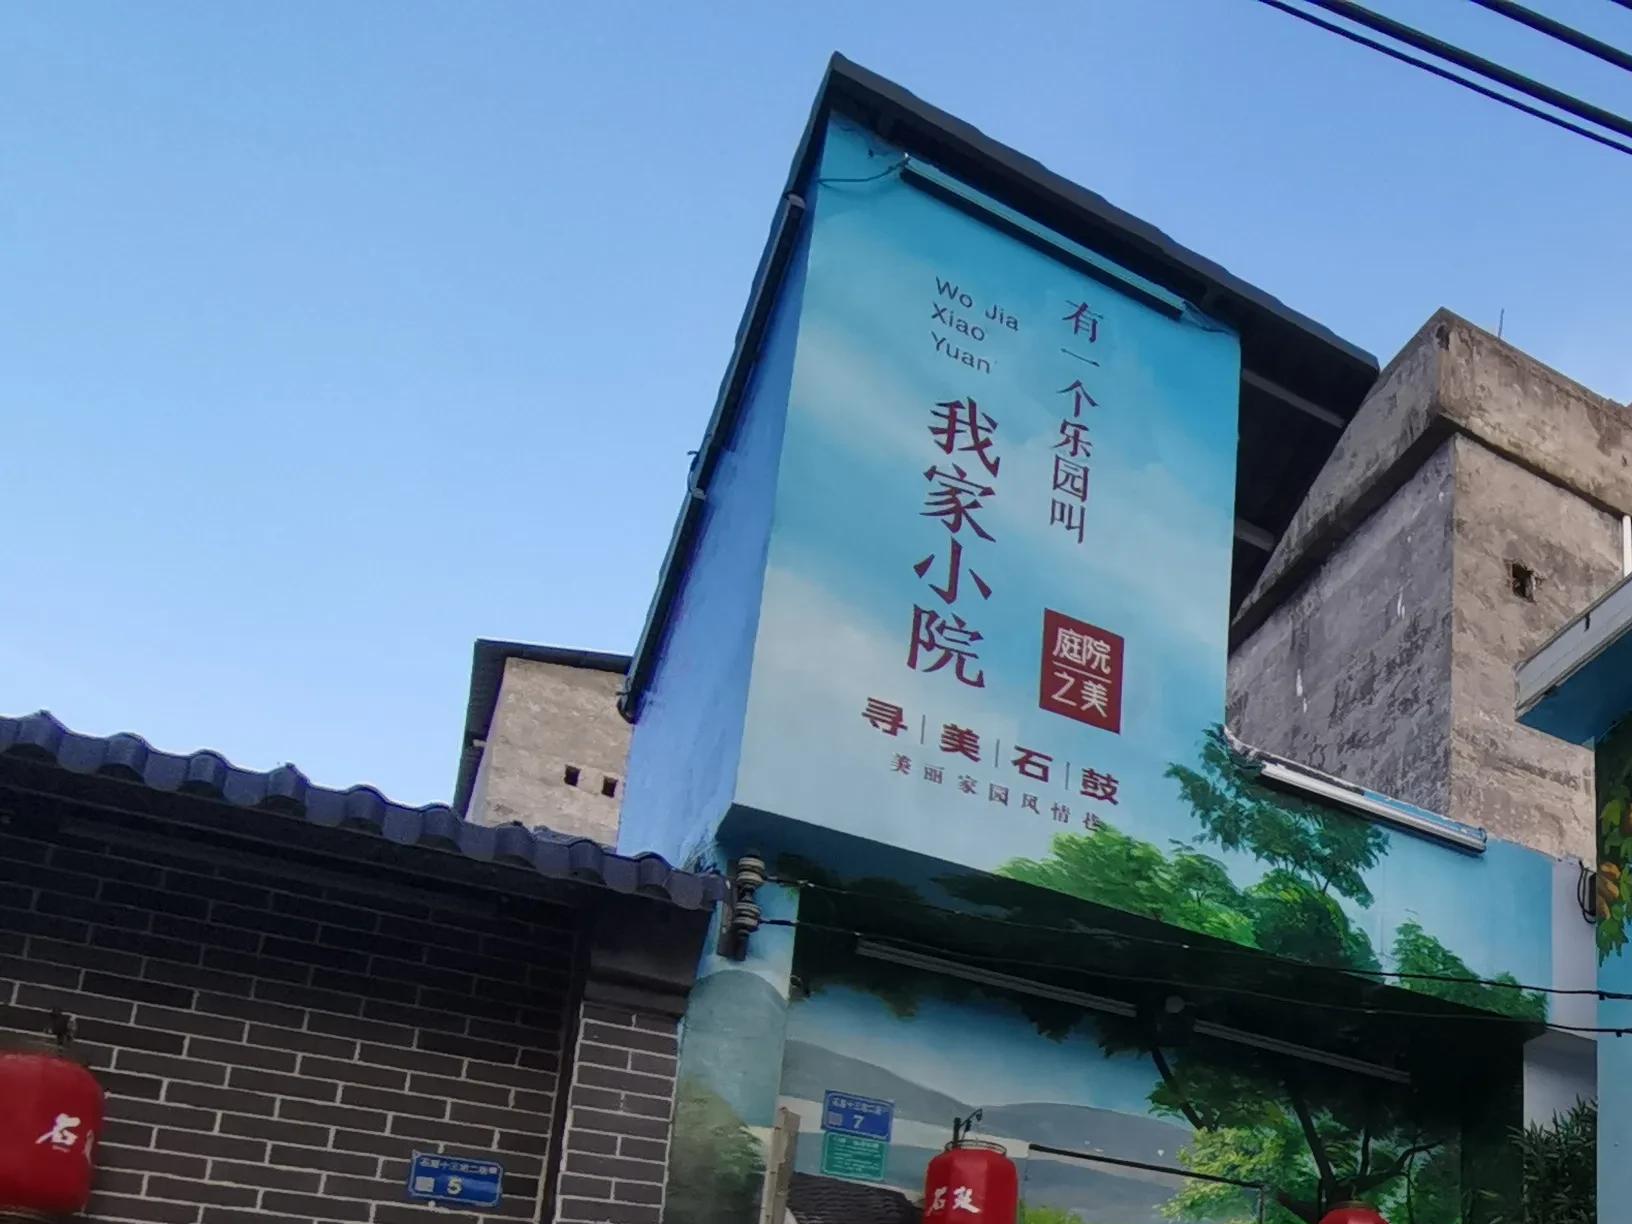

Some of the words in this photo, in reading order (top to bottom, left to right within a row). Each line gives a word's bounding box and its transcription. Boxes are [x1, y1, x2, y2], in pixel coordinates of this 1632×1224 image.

[931, 301, 985, 342] Xiao
[936, 275, 973, 309] Wo
[985, 304, 1019, 332] Jia
[930, 330, 990, 374] Yuan
[1049, 299, 1104, 544] 有一个乐园叫
[906, 397, 1000, 689] 我家小院
[1052, 626, 1111, 675] 庭院
[1051, 671, 1109, 718] 之美
[853, 1114, 864, 1129] 7
[447, 1175, 463, 1195] 5
